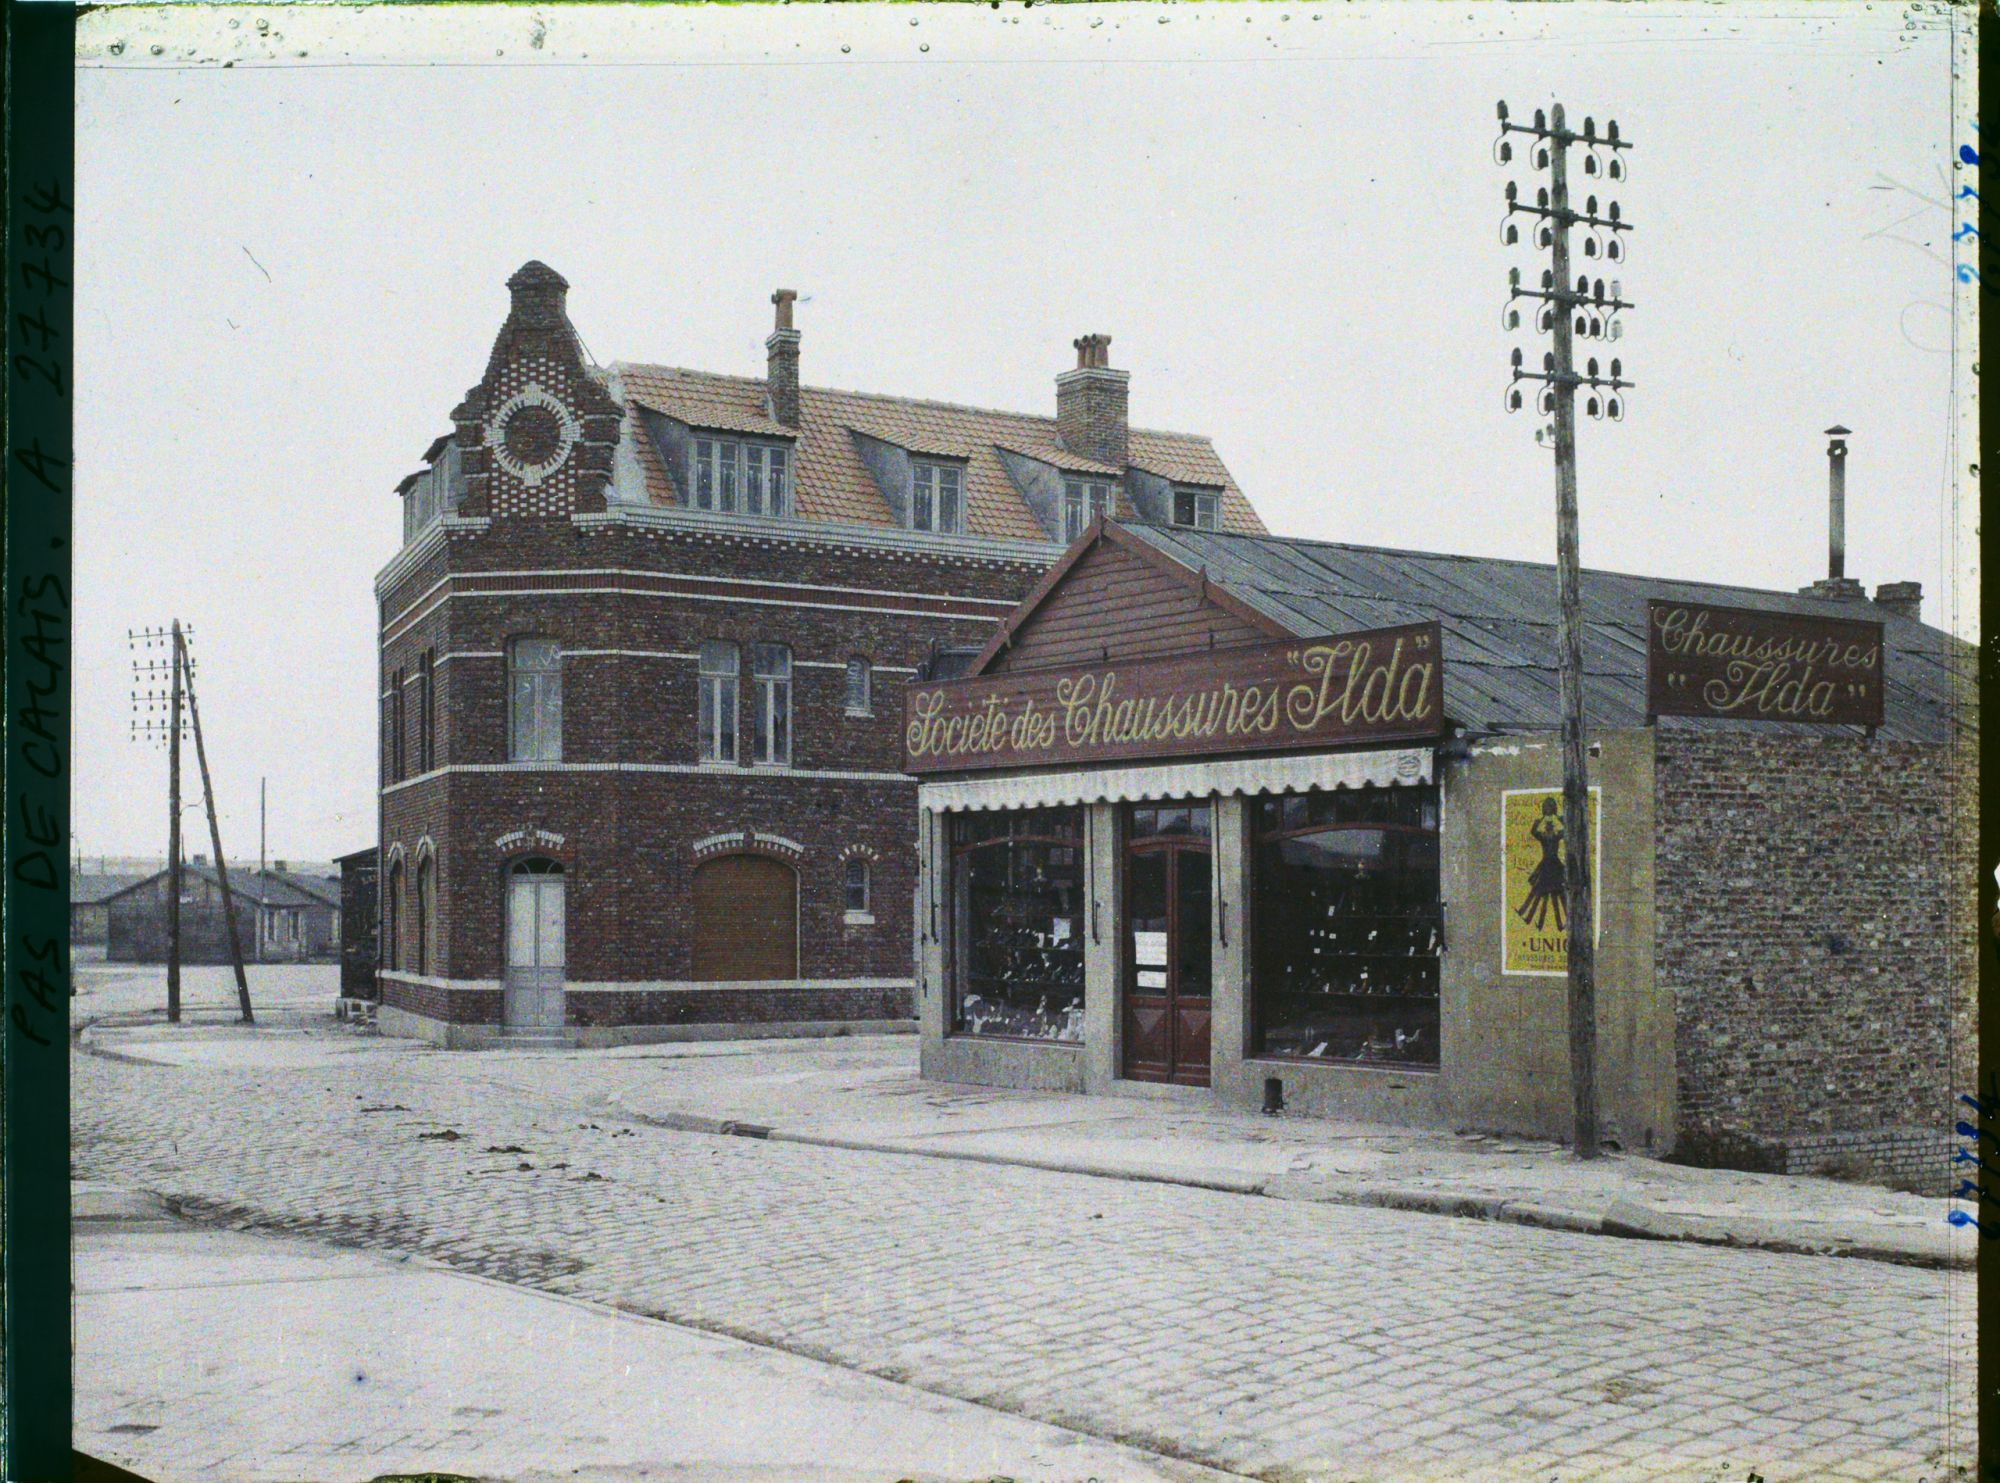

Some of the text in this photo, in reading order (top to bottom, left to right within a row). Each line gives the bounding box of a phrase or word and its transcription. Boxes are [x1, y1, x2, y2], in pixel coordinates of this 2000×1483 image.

[14, 176, 74, 397] 27734
[15, 437, 67, 493] A
[1654, 606, 1878, 669] Chaussures
[1011, 699, 1055, 749] des
[1057, 671, 1279, 748] Chaussures
[14, 791, 61, 891] DE
[11, 933, 62, 1046] PAS
